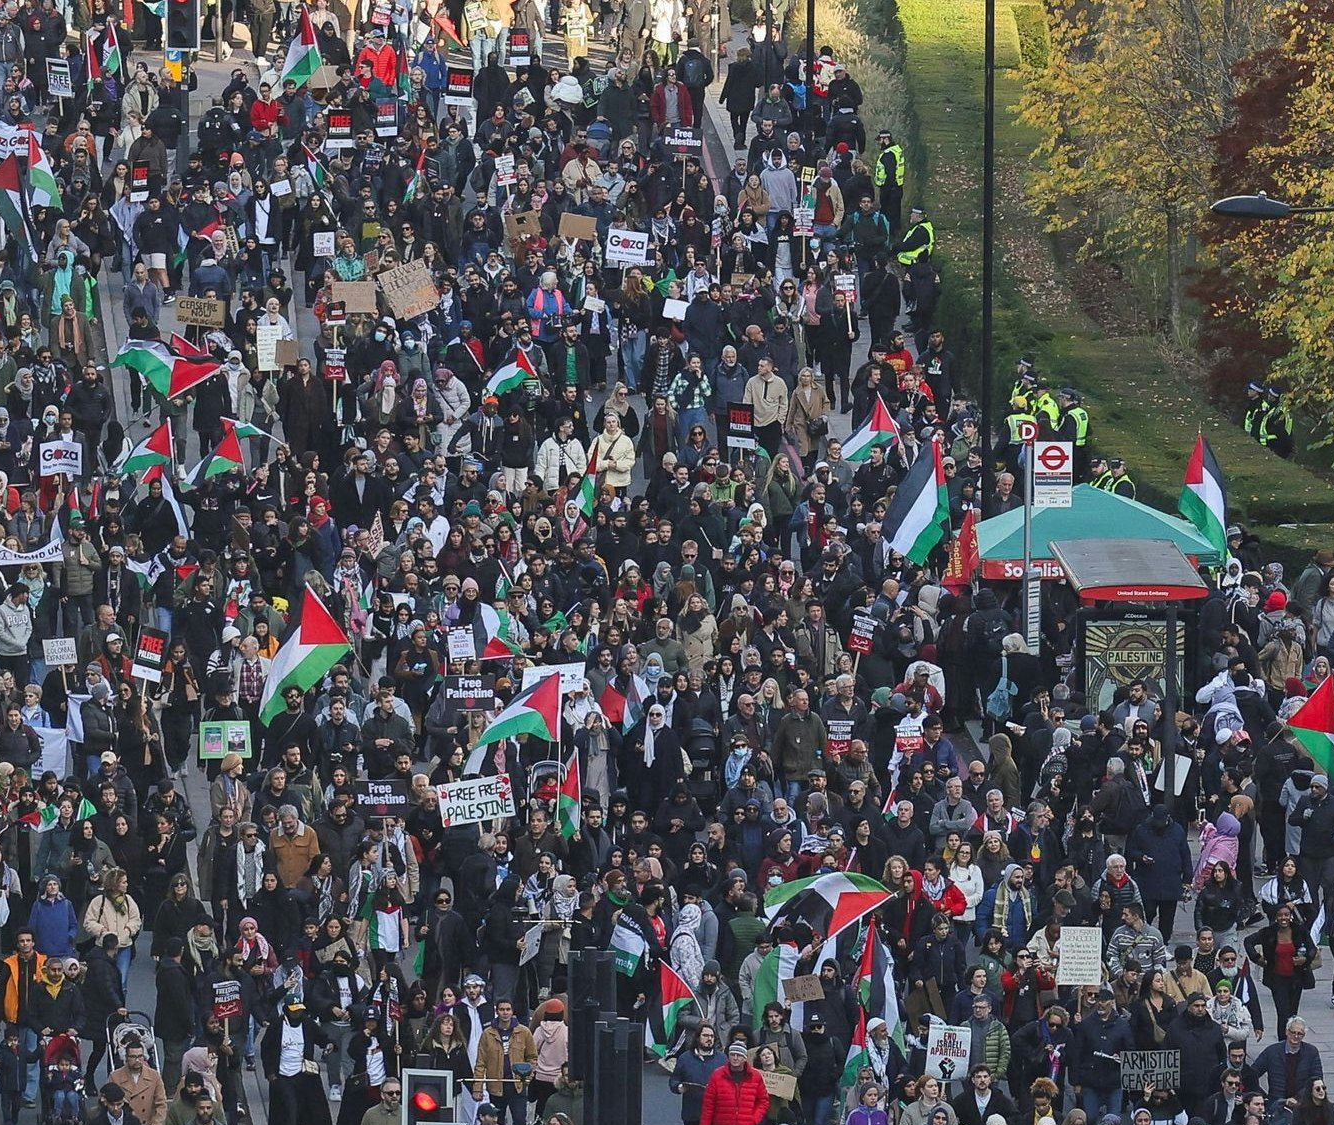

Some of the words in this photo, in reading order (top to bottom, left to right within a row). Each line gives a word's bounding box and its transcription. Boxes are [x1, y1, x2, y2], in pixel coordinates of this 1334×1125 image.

[511, 35, 529, 46] FREE
[450, 73, 472, 85] FREE
[378, 104, 395, 115] FREE
[330, 116, 352, 127] FREE
[674, 129, 693, 138] Free
[665, 135, 702, 147] Palestine
[179, 299, 219, 312] CEASEFIRE
[191, 309, 212, 317] NOW
[730, 411, 752, 423] FREE
[1021, 424, 1035, 440] D
[47, 544, 62, 557] UK
[954, 540, 963, 578] Socialist
[1149, 590, 1169, 598] Embassy
[7, 613, 31, 626] POLO
[854, 620, 875, 632] FREEDOM
[851, 628, 874, 641] PALESTINE
[50, 640, 67, 648] STOP
[140, 634, 165, 653] FREE
[47, 647, 75, 655] COLONIAL
[137, 649, 162, 663] PALESTINE
[1108, 652, 1163, 663] PALESTINE
[458, 677, 482, 688] Free
[446, 687, 494, 699] Palestine
[828, 732, 852, 741] PALESTINE
[368, 783, 393, 794] Free
[448, 787, 476, 803] FREE
[478, 781, 503, 798] FREE
[358, 793, 407, 806] Palestine
[447, 799, 513, 821] PALESTINE
[215, 986, 240, 996] FREEDOM
[214, 995, 241, 1004] PALESTINE
[943, 1032, 957, 1040] END
[937, 1038, 964, 1049] ISRAELI
[930, 1046, 967, 1058] APARTHEID
[1122, 1051, 1180, 1071] ARMISTICE
[1121, 1069, 1180, 1091] CEASEFIRE
